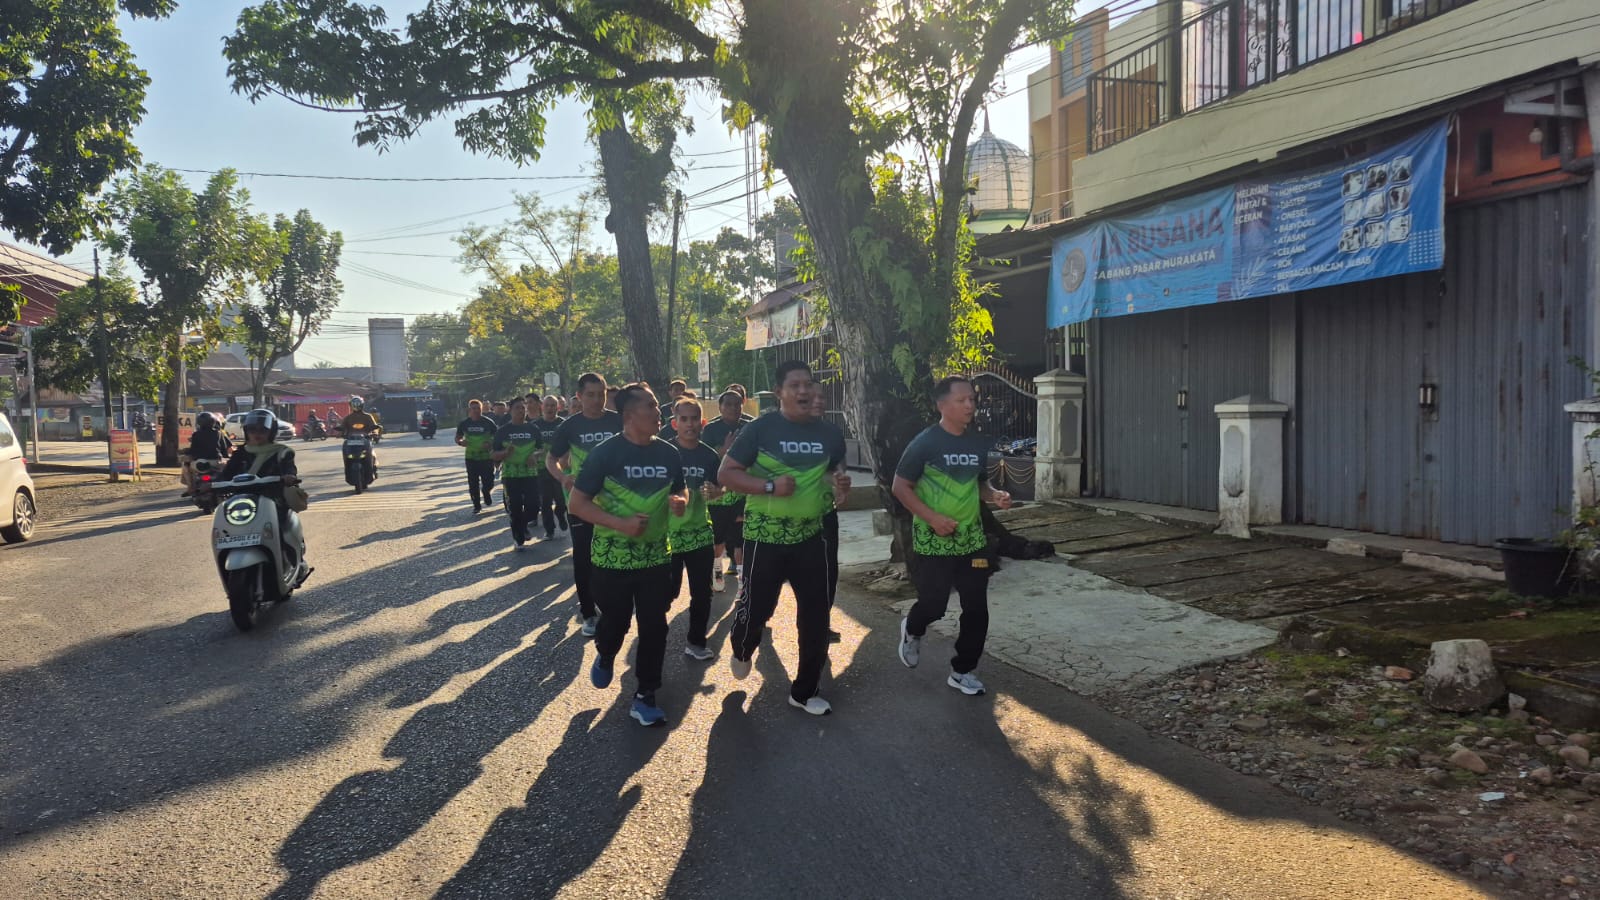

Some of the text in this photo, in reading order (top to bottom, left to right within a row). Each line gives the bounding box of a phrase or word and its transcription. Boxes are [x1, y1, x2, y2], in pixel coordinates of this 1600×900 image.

[1237, 183, 1269, 198] MELAYANI
[1280, 196, 1306, 209] DASTER
[1235, 211, 1263, 225] ECERAN
[1128, 206, 1224, 254] BUSANA
[1277, 232, 1306, 244] ATASAN
[1133, 261, 1161, 275] PASAR
[1162, 250, 1216, 268] MURAKATA
[1277, 265, 1312, 281] BERBAGAI
[1312, 261, 1344, 274] MACAM
[579, 431, 614, 443] 1002
[779, 441, 823, 454] 1002
[943, 453, 979, 466] 1002
[624, 465, 667, 478] 1002
[681, 466, 705, 478] 002
